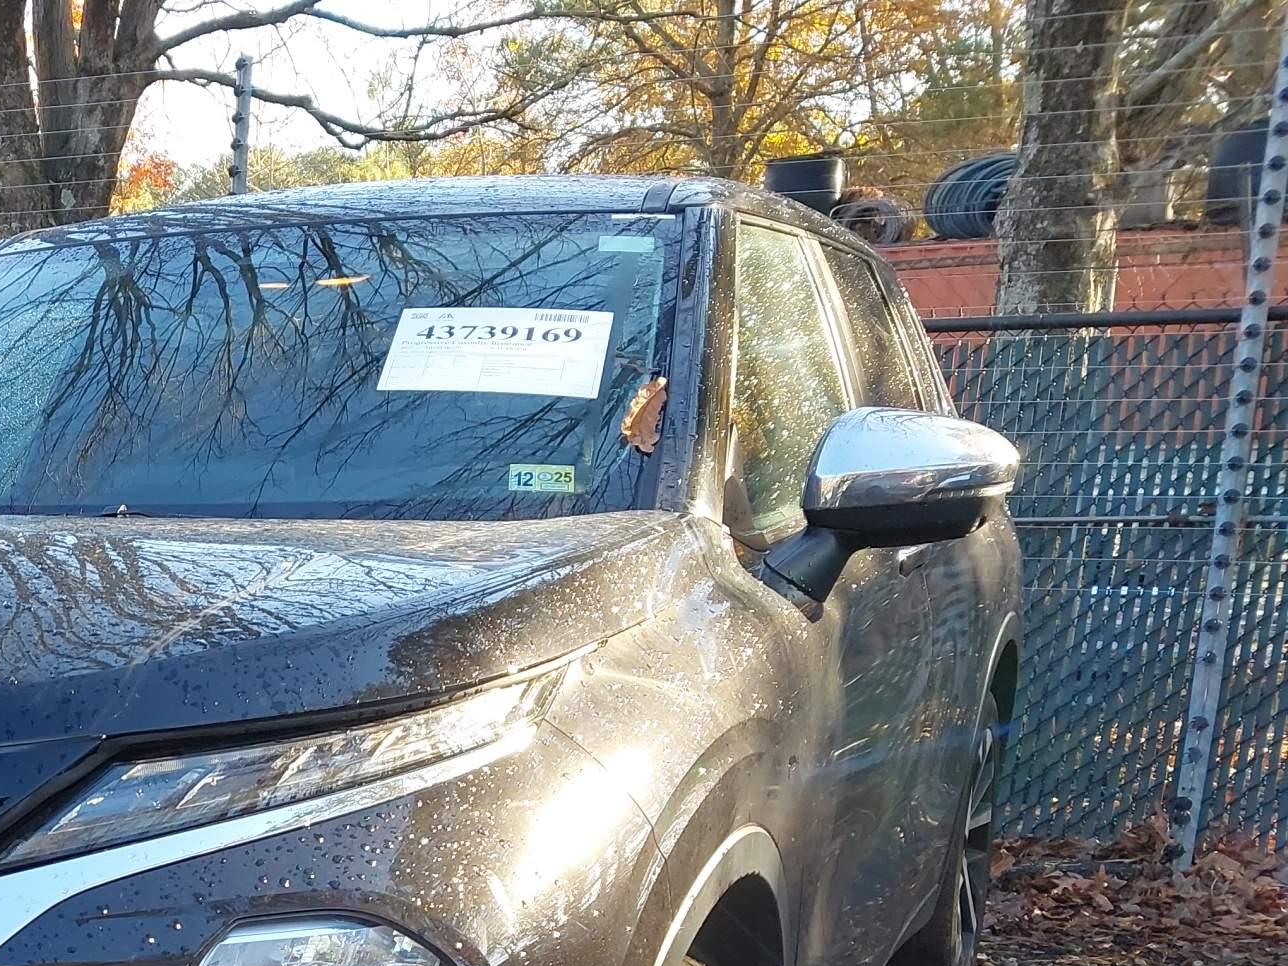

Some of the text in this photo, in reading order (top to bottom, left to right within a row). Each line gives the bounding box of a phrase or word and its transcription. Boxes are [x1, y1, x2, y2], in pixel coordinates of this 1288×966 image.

[416, 325, 583, 343] 43739169
[514, 471, 533, 487] 12
[554, 471, 573, 483] 25
